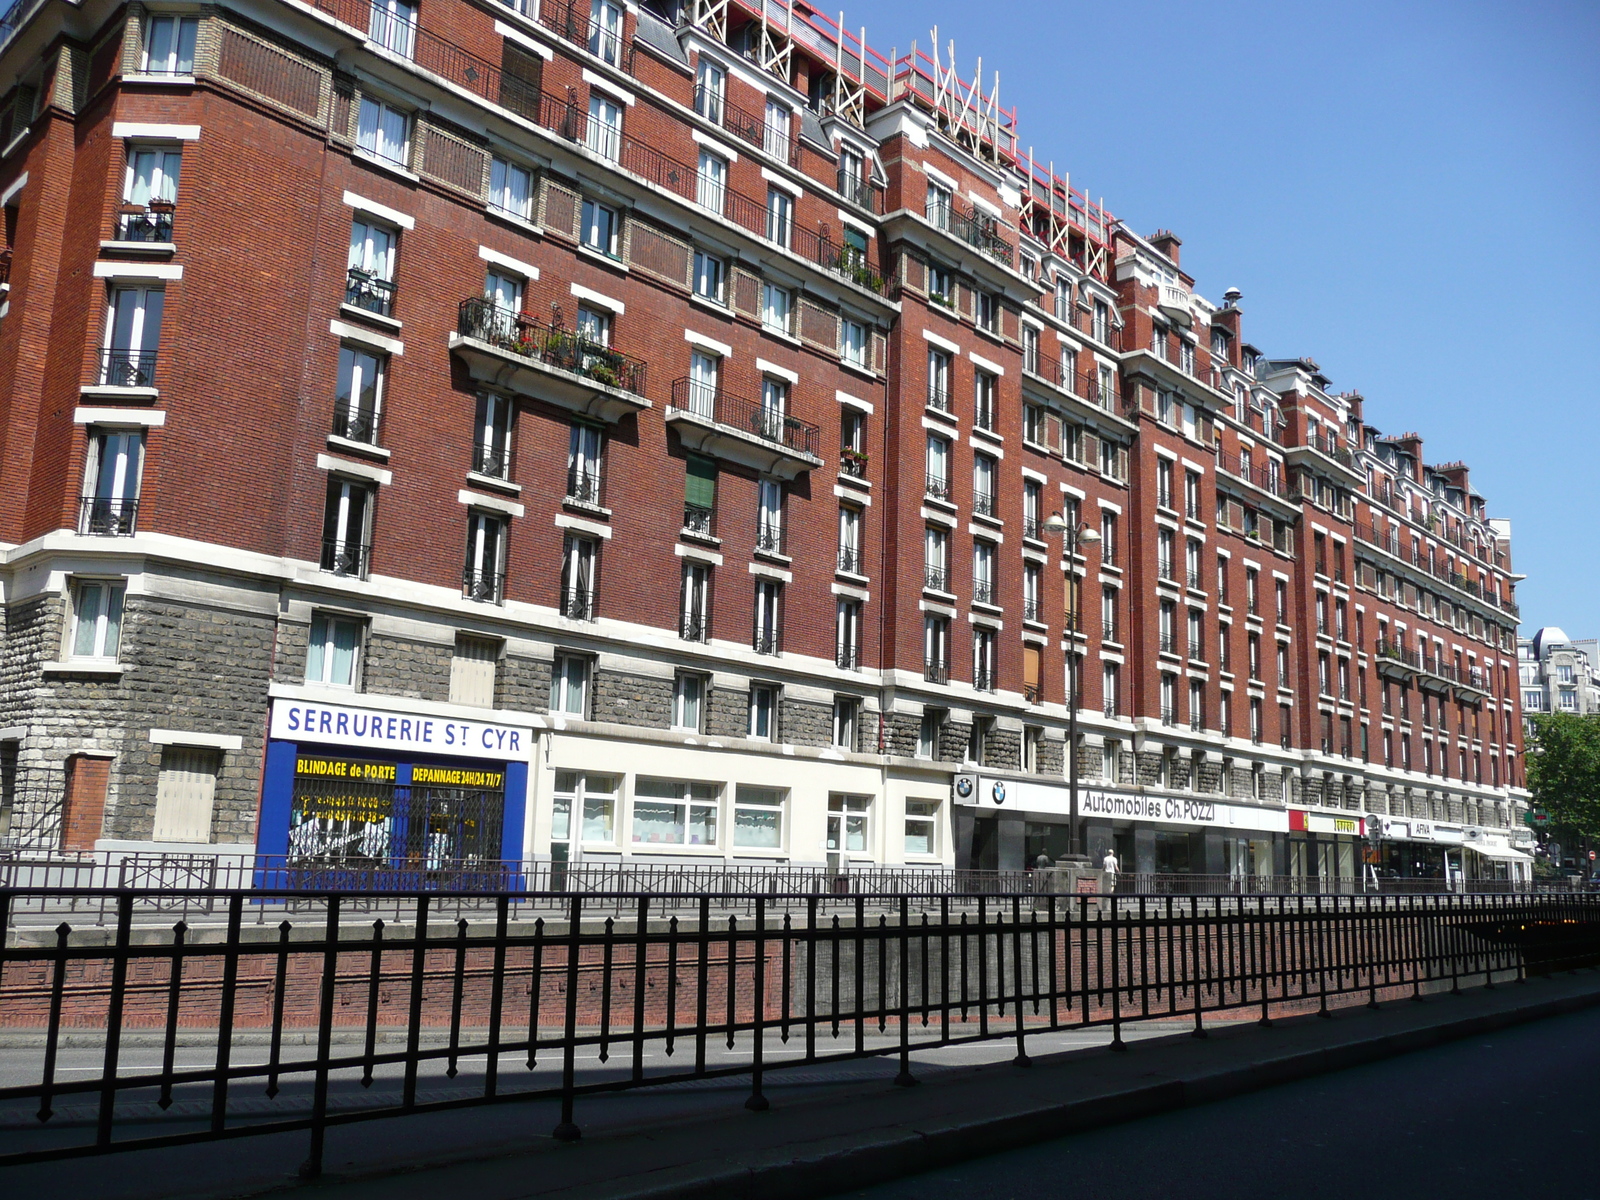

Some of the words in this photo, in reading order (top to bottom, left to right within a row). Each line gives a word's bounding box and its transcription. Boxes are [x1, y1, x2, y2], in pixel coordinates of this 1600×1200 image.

[288, 707, 433, 743] SERRURERIE
[481, 728, 520, 751] CYR
[297, 759, 347, 777] BLINDAGE
[350, 763, 362, 777] de
[364, 764, 396, 780] PORTE
[412, 767, 460, 785] DEPANNAGE
[460, 771, 485, 787] 24H/24
[1083, 790, 1161, 818] Automobiles
[1184, 801, 1215, 822] POZZI
